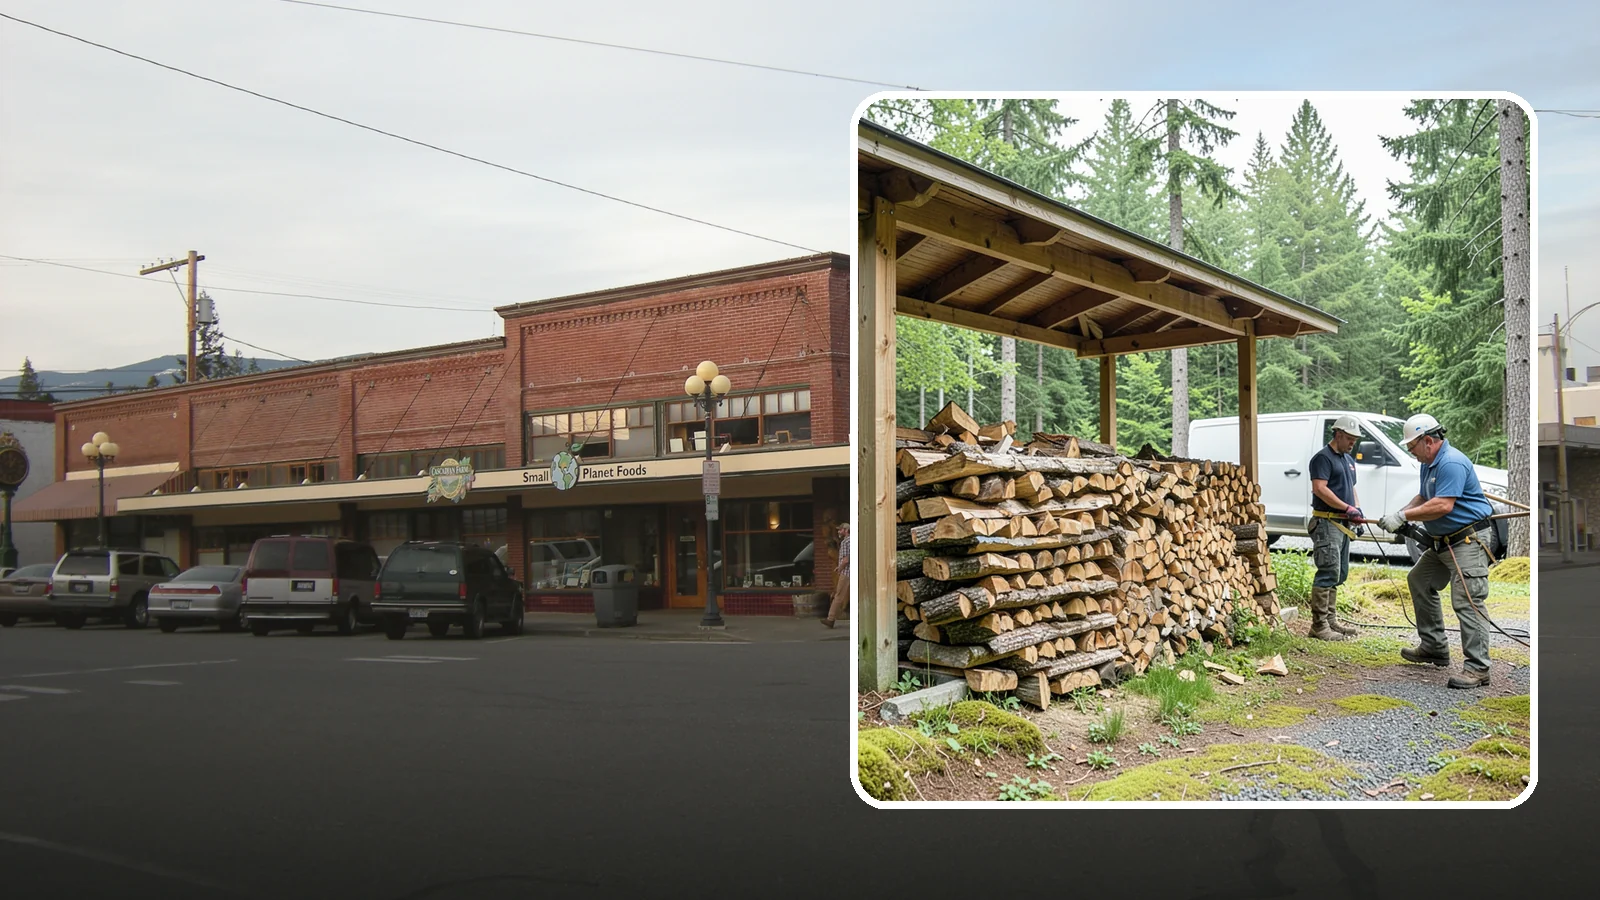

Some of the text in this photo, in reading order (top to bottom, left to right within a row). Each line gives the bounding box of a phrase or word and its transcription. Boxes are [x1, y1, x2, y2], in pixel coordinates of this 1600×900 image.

[523, 464, 646, 482] Small Planet Foods
